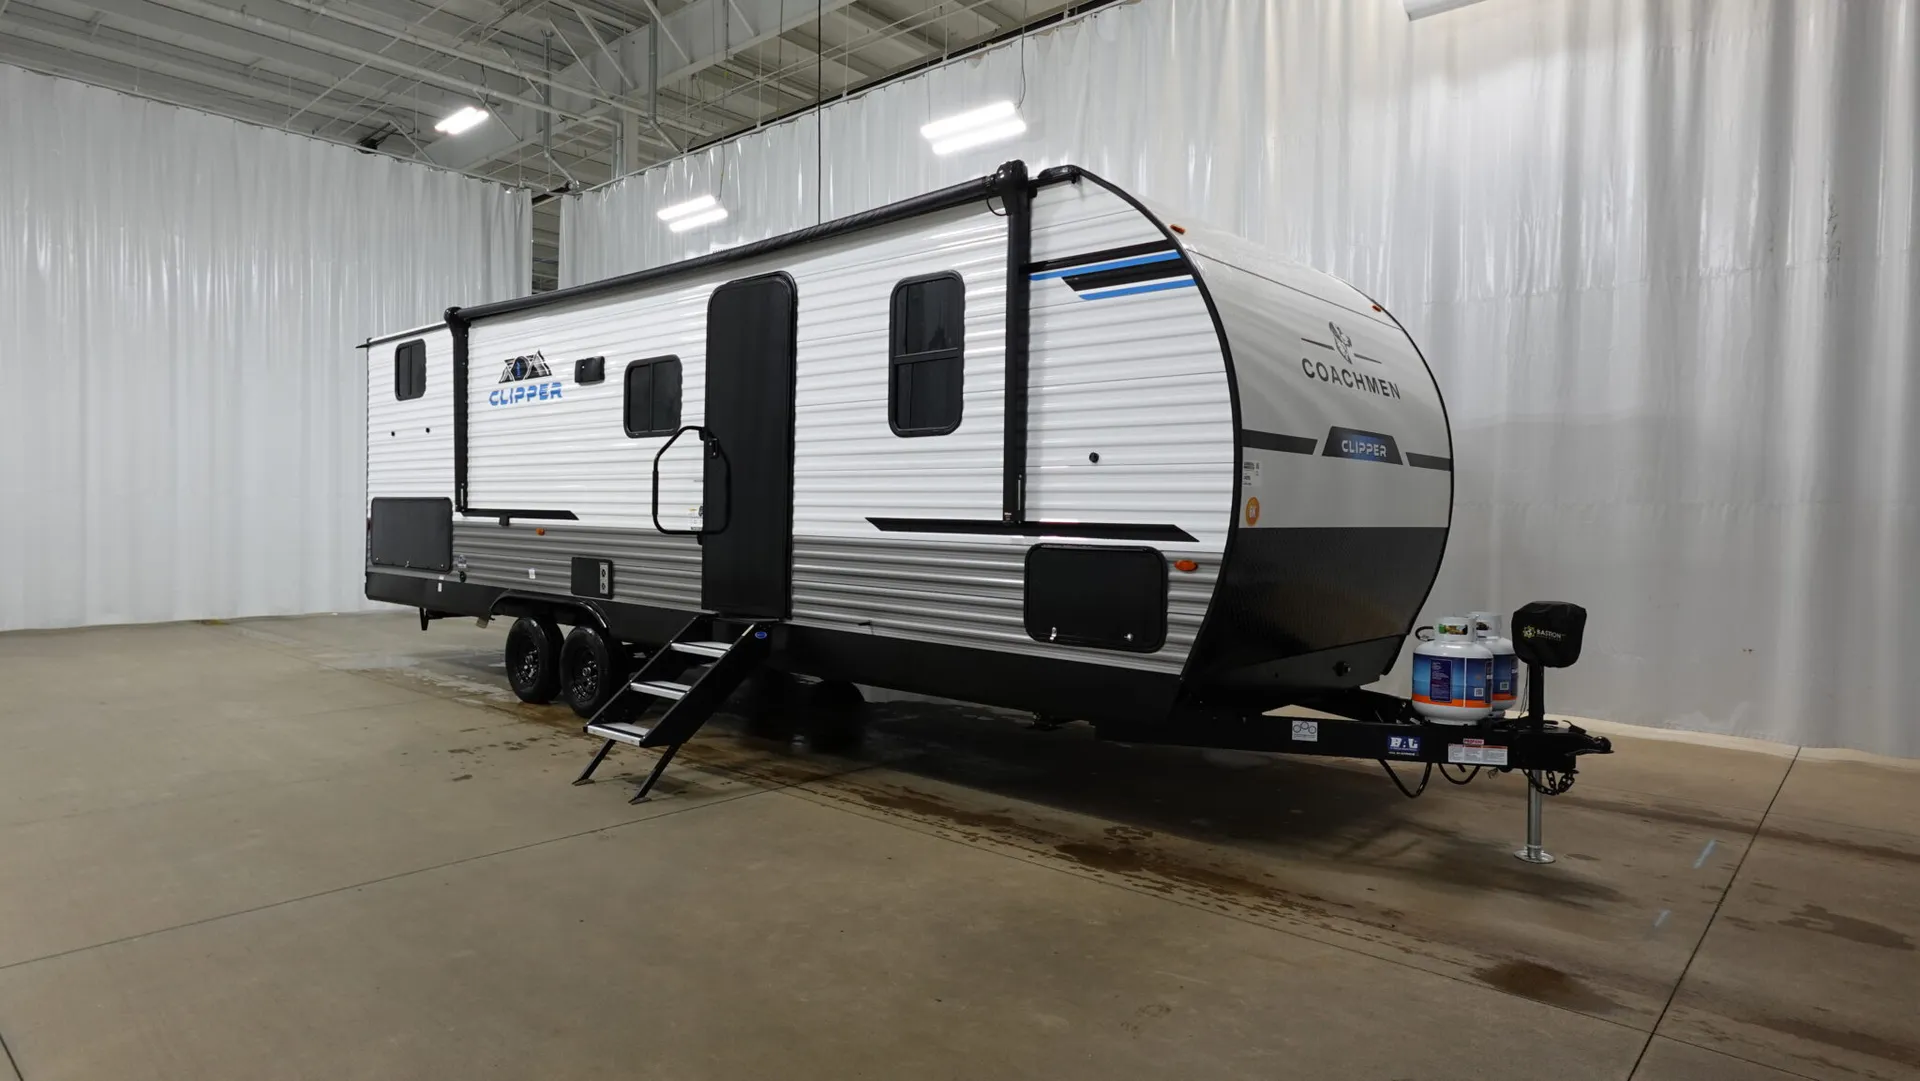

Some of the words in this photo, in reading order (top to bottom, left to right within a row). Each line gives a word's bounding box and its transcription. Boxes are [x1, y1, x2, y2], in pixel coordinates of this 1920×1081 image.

[1302, 358, 1401, 400] COACHMEN
[489, 382, 562, 406] CLIPPER
[1341, 440, 1387, 457] CLIPPER
